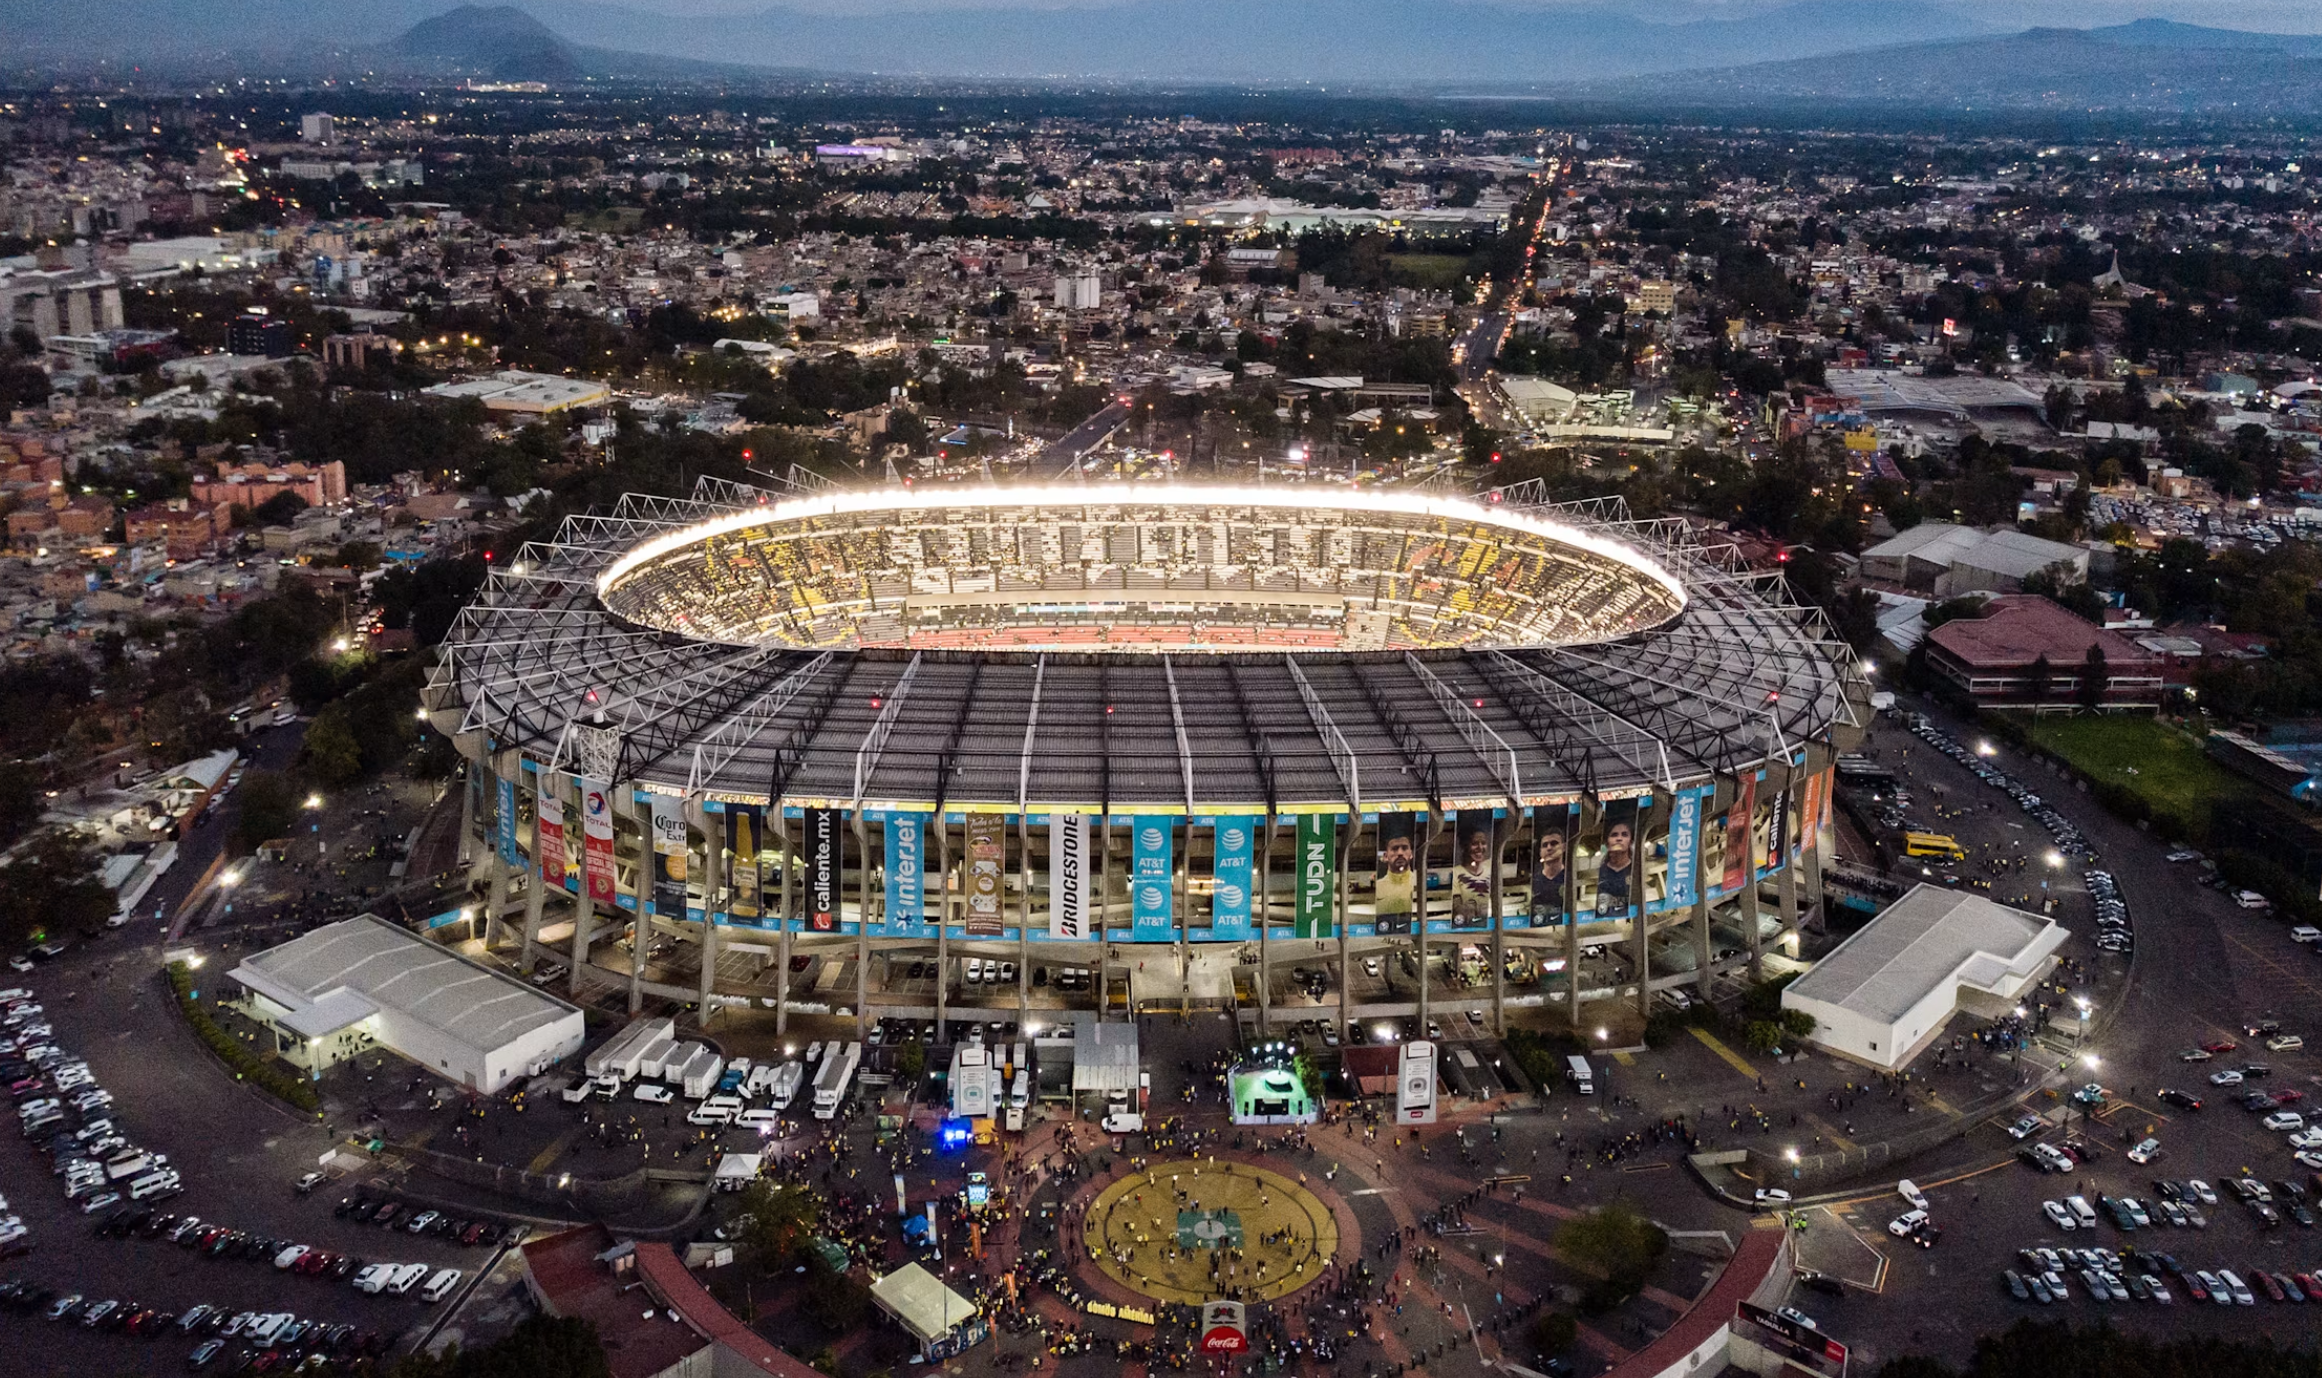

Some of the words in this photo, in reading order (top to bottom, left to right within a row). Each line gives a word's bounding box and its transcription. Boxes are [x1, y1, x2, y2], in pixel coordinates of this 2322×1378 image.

[539, 799, 563, 814] TOTAL
[585, 815, 611, 828] TOTAL
[655, 814, 686, 833] Coro
[1769, 789, 1783, 851] caliente
[666, 830, 685, 841] Extr
[814, 811, 830, 912] caliente.mx
[1138, 857, 1165, 868] AT&T
[1219, 857, 1246, 868] AT&T
[1061, 815, 1078, 937] BRIDGESTONE
[1306, 843, 1325, 914] TUDN
[1138, 916, 1166, 927] AT&T
[1218, 915, 1244, 926] AT&T
[1755, 1316, 1790, 1337] TAQUILLA
